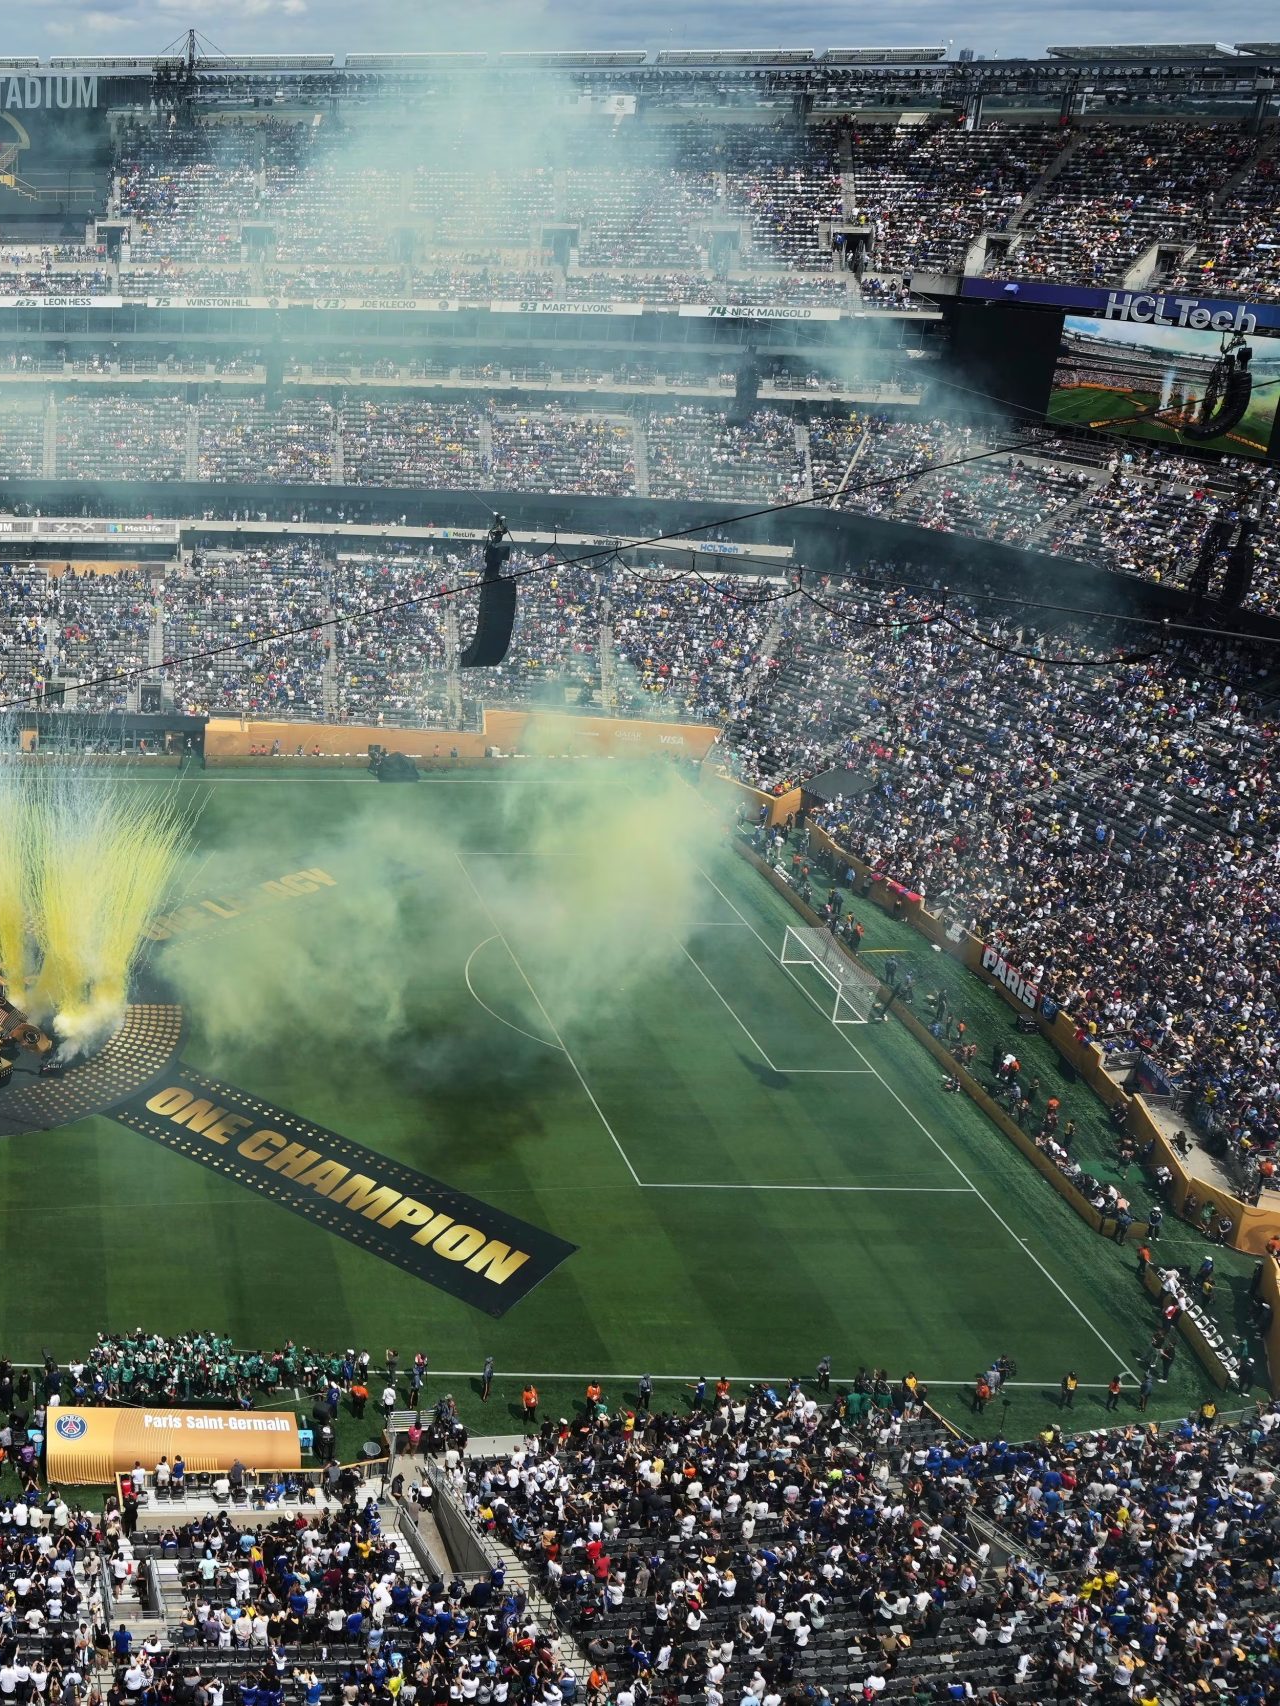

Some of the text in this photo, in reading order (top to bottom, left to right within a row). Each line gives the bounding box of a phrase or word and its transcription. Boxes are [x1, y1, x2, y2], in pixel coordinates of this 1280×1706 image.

[43, 297, 67, 306] LEON
[69, 297, 92, 306] HESS
[155, 297, 251, 307] 75 WINSTON HILL
[359, 300, 378, 309] JOE
[379, 300, 417, 309] KLECKO
[520, 302, 614, 313] 93 MARTY LYONS
[731, 307, 755, 318] NICK
[757, 308, 812, 318] MANGOLD
[1104, 292, 1257, 333] HCLTech
[125, 524, 161, 532] MetLife
[452, 531, 476, 539] MetLife
[593, 538, 623, 546] verizon
[700, 543, 739, 554] HCLTech
[659, 735, 685, 745] VISA
[982, 947, 1039, 1009] PARIS
[145, 1086, 531, 1285] ONE CHAMPION
[144, 1415, 290, 1431] Paris Saint-Germain
